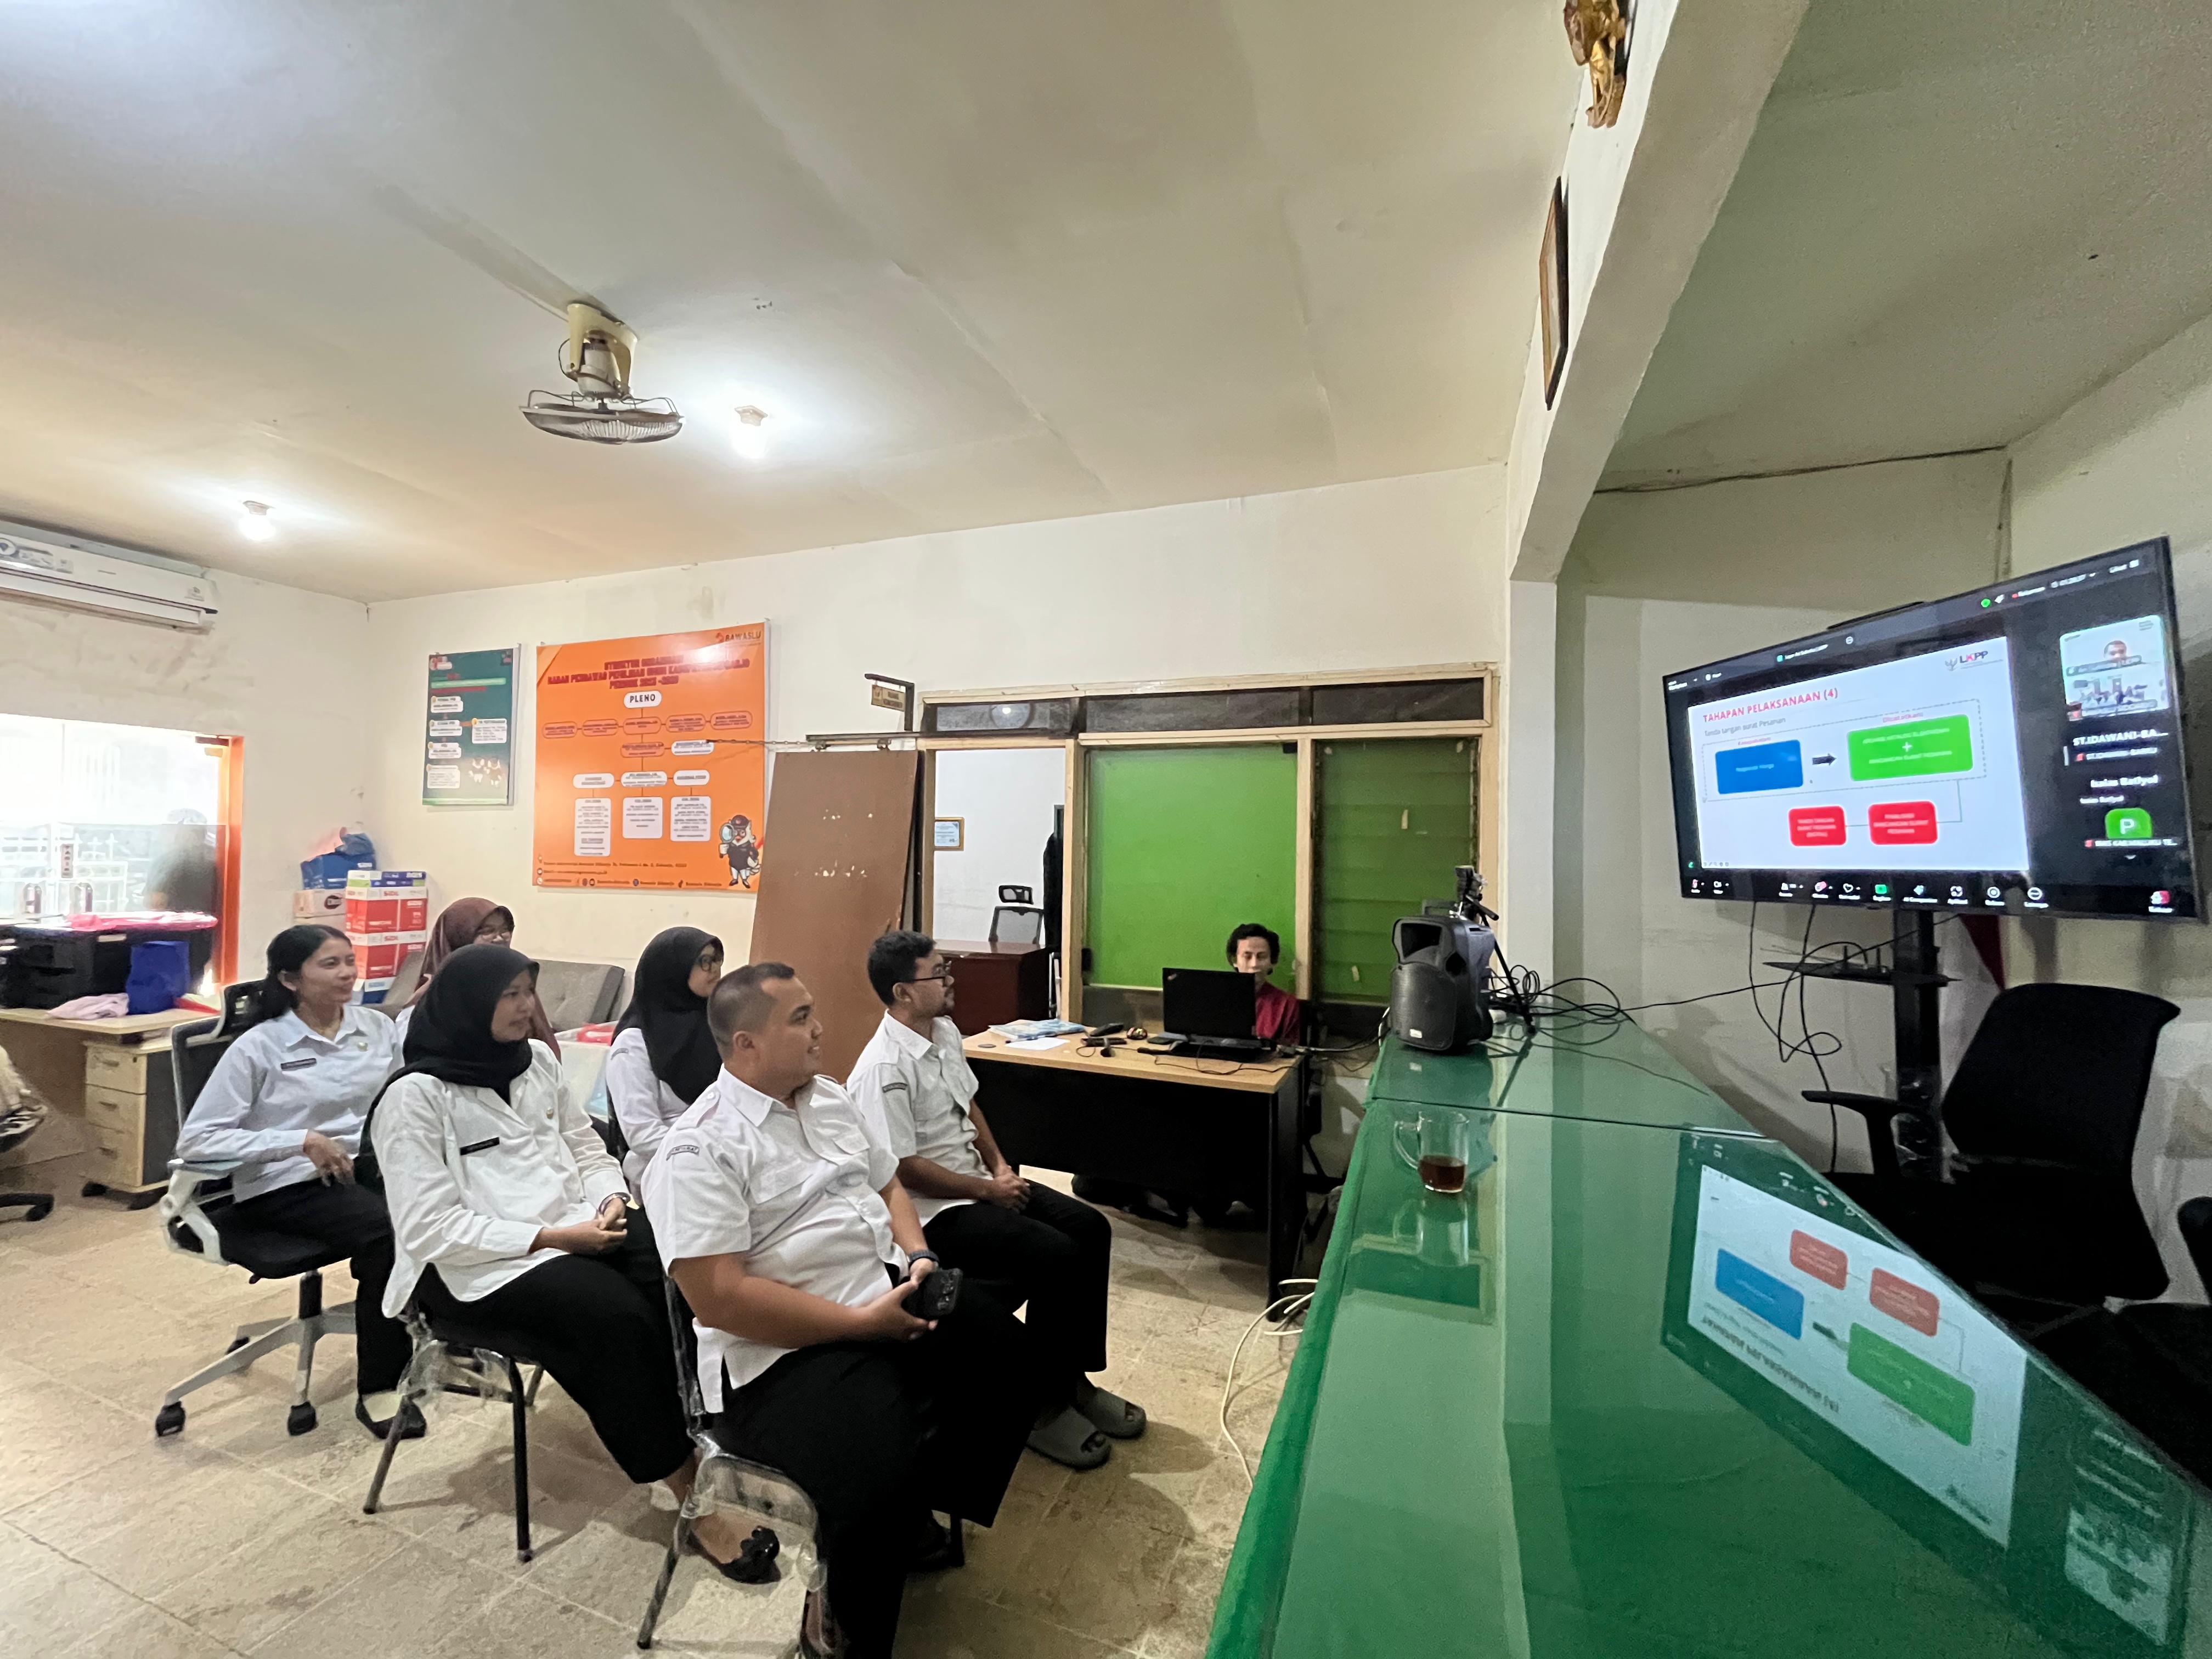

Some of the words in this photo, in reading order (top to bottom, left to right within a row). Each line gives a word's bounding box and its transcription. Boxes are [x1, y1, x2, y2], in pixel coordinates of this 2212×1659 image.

[630, 693, 656, 703] PLENO
[1703, 707, 1744, 722] TAHAPAN
[1747, 691, 1820, 714] PELAKSANAAN
[1824, 687, 1838, 701] (4)
[2119, 818, 2135, 834] P
